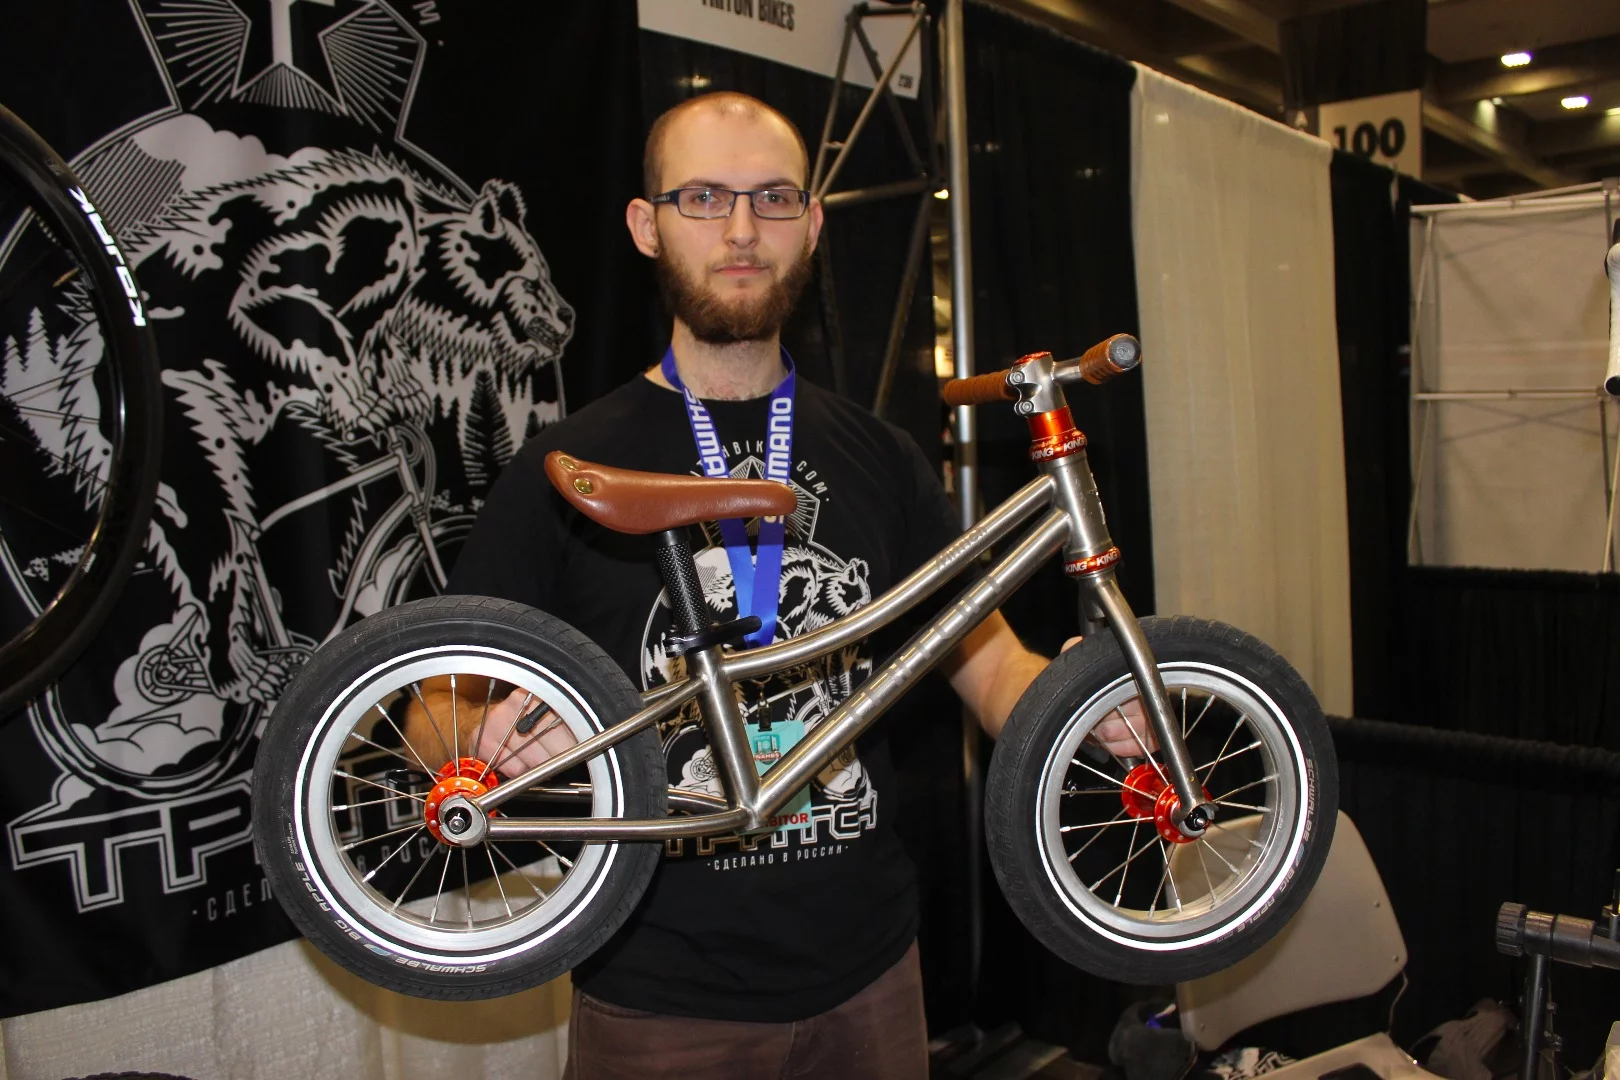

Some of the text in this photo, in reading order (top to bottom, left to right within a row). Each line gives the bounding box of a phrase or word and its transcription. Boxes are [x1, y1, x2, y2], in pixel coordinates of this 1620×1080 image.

[758, 0, 795, 31] BIKES
[1333, 116, 1406, 158] 100
[1031, 447, 1054, 460] KING
[1063, 437, 1085, 452] KING
[1065, 550, 1118, 573] KING KING
[714, 845, 842, 871] СДЕЛАНО В РОССИИ
[1237, 758, 1317, 932] SCHWALBE BIG APPLE
[295, 861, 487, 974] SCHWALBE BIG APPLE
